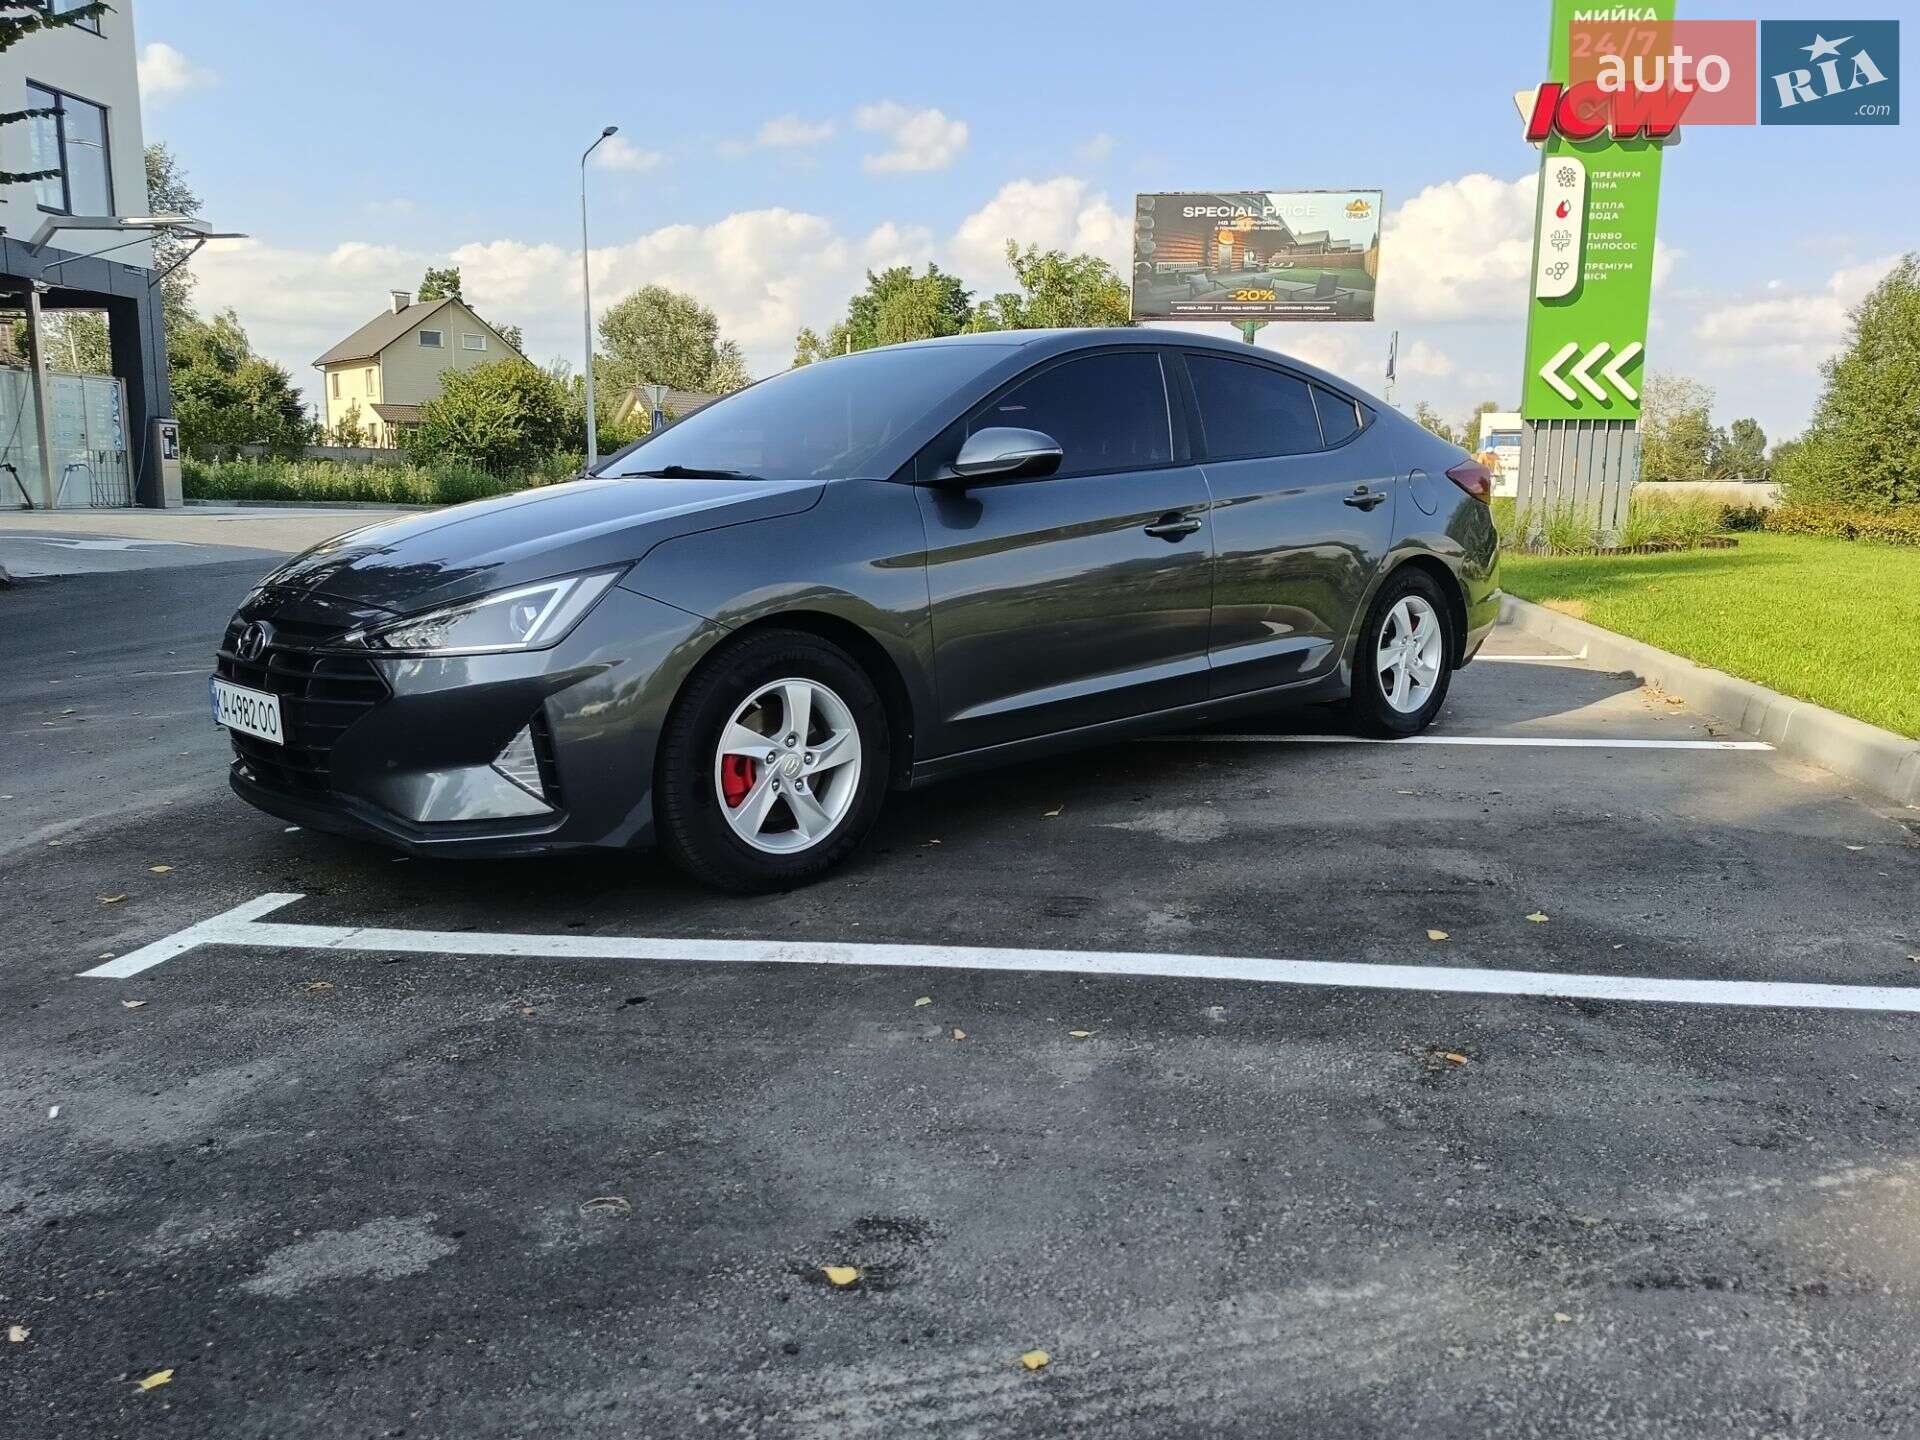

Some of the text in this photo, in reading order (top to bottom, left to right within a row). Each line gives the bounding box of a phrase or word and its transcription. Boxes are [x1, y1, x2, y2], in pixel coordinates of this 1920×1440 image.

[1573, 5, 1658, 25] МИЙКА
[1572, 29, 1658, 58] 24/7
[1592, 171, 1641, 179] ПРЕМІУМ
[1182, 204, 1317, 218] SPECIAL PRICE
[1589, 212, 1619, 220] ВОДА
[1587, 232, 1623, 240] TURBO
[1586, 242, 1637, 250] ПИЛОСОС
[1584, 262, 1633, 270] ПРЕМІУМ
[1583, 272, 1608, 280] ВІСК
[1227, 289, 1276, 301] -20%
